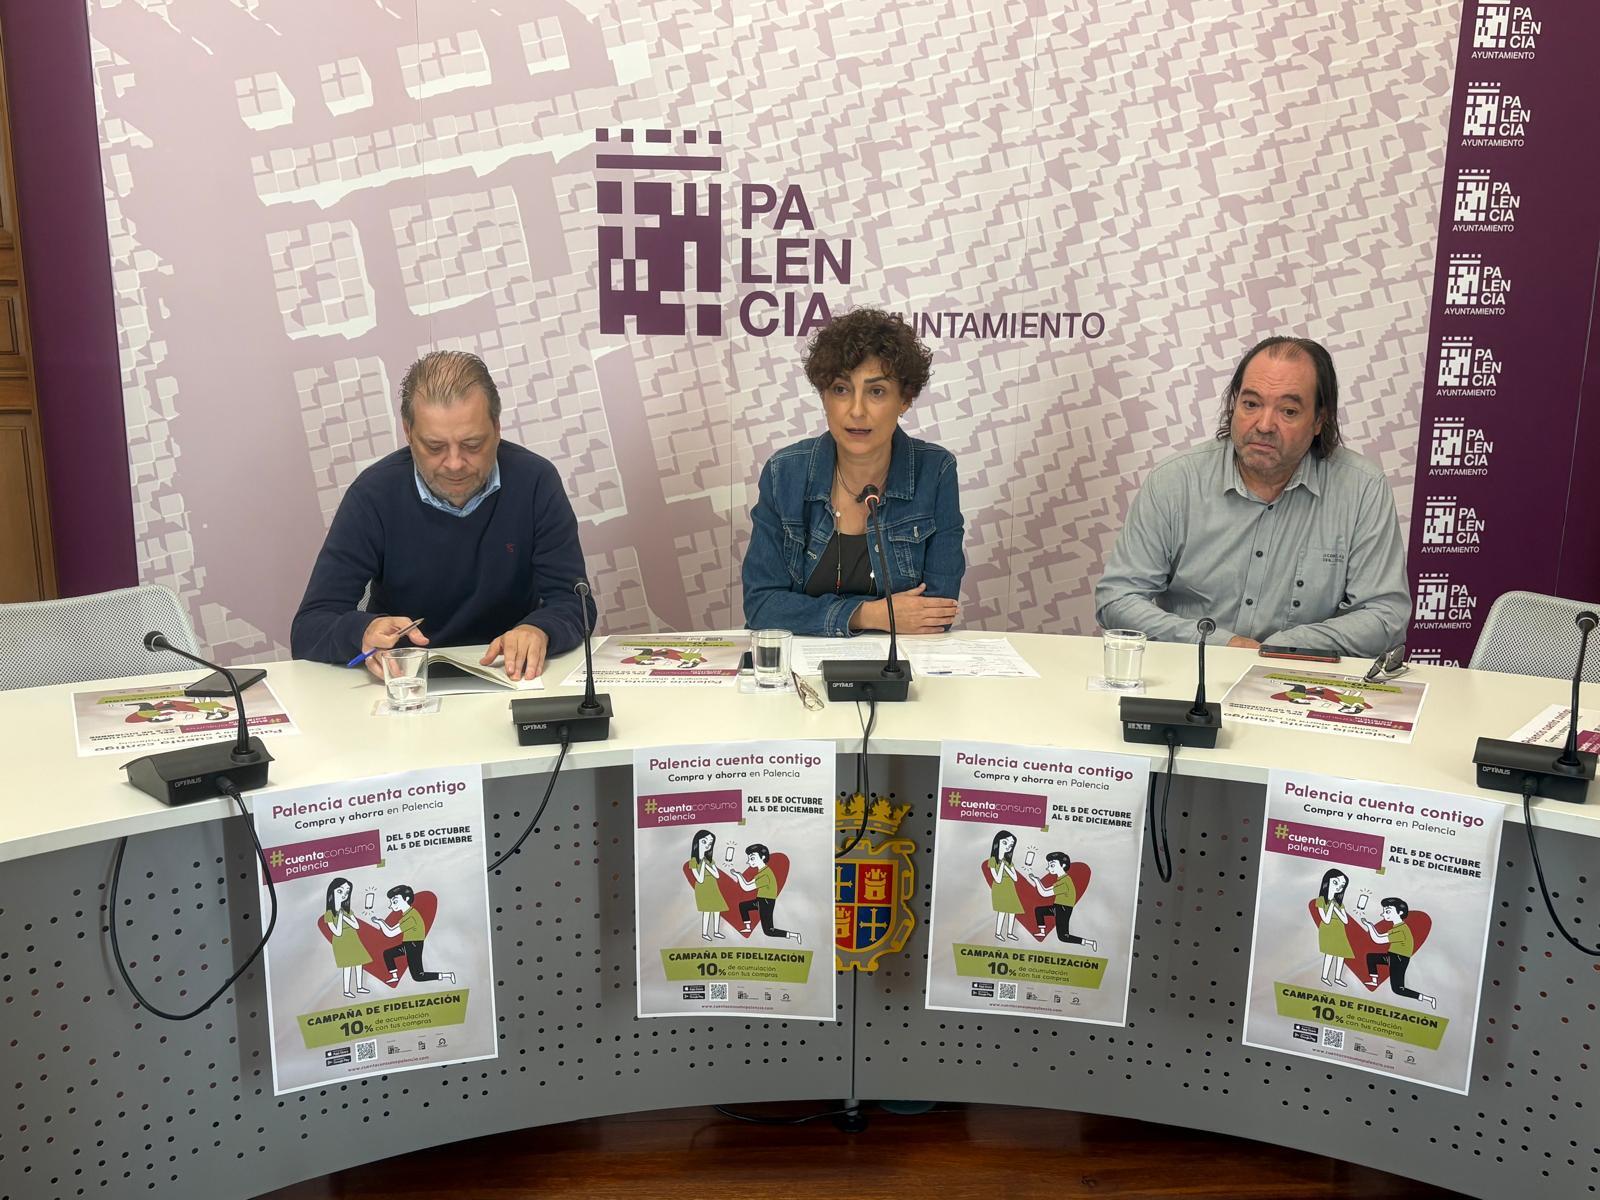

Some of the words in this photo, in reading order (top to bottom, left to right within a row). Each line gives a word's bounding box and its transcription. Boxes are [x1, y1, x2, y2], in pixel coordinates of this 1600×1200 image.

[1513, 7, 1533, 20] PA
[1511, 22, 1542, 35] LEN
[1509, 35, 1536, 49] CIA
[1471, 51, 1535, 60] AYUNTAMIENTO
[1502, 95, 1522, 109] PA
[1500, 109, 1531, 123] LEN
[1499, 123, 1525, 136] CIA
[1461, 139, 1525, 147] AYUNTAMIENTO
[1492, 182, 1511, 195] PA
[741, 183, 815, 230] PA
[1490, 195, 1520, 208] LEN
[1489, 209, 1515, 222] CIA
[1452, 224, 1514, 232] AYUNTAMIENTO
[741, 238, 852, 285] LEN
[1483, 266, 1502, 279] PA
[1482, 279, 1511, 292] LEN
[1480, 293, 1506, 305] CIA
[739, 290, 833, 338] CIA
[1444, 307, 1506, 315] AYUNTAMIENTO
[1475, 348, 1493, 361] PA
[1473, 361, 1502, 374] LEN
[1472, 374, 1497, 387] CIA
[1466, 429, 1485, 441] PA
[1465, 441, 1494, 454] LEN
[1463, 454, 1488, 466] CIA
[1428, 468, 1488, 476] AYUNTAMIENTO
[1458, 507, 1477, 519] PA
[1457, 520, 1485, 532] LEN
[1456, 532, 1480, 544] CIA
[1450, 584, 1468, 596] PA
[1449, 596, 1477, 608] LEN
[1448, 608, 1472, 620] CIA
[522, 723, 548, 731] OPTIMUS
[650, 756, 711, 771] Palencia
[715, 753, 764, 767] cuenta
[769, 753, 821, 768] contigo
[956, 752, 1018, 768] Palencia
[1023, 761, 1073, 773] cuenta
[1078, 766, 1133, 782] contigo
[668, 774, 704, 782] Compra
[715, 771, 747, 779] ahorra
[763, 769, 800, 778] Palencia
[1482, 766, 1511, 775] OPTIMUS
[174, 776, 202, 788] OPTIMUS
[973, 770, 1010, 781] Compra
[1021, 775, 1054, 785] ahorra
[1071, 779, 1109, 790] Palencia
[273, 797, 342, 819] Palencia
[348, 788, 402, 806] cuenta
[408, 780, 466, 796] contigo
[644, 798, 738, 814] #cuentaconsumo
[785, 796, 823, 805] OCTUBRE
[948, 791, 1042, 815] #cuentaconsumo
[1285, 782, 1353, 805] Palencia
[1359, 797, 1414, 814] cuenta
[1420, 808, 1484, 828] contigo
[294, 817, 336, 829] Compra
[339, 816, 345, 824] y
[348, 810, 384, 821] ahorra
[402, 800, 443, 812] Palencia
[780, 806, 824, 814] DICIEMBRE
[960, 808, 999, 819] palencia
[1052, 804, 1068, 812] DEL
[1091, 808, 1131, 819] OCTUBRE
[657, 812, 696, 823] palencia
[1086, 817, 1132, 828] DICIEMBRE
[1303, 804, 1344, 817] Compra
[1347, 812, 1353, 820] y
[1356, 812, 1392, 825] ahorra
[1412, 821, 1456, 836] Palencia
[386, 833, 404, 842] DEL
[413, 830, 425, 838] DE
[428, 826, 470, 836] OCTUBRE
[1273, 823, 1378, 855] #cuentaconsumo
[387, 844, 398, 852] AL
[409, 840, 421, 848] DE
[423, 835, 472, 846] DICIEMBRE
[1287, 842, 1330, 856] palencia
[270, 841, 375, 868] #cuentaconsumo
[1390, 845, 1408, 855] DEL
[1419, 851, 1432, 859] DE
[1434, 854, 1481, 869] OCTUBRE
[285, 859, 329, 877] palencia
[1389, 855, 1401, 863] AL
[1412, 859, 1425, 868] DE
[1428, 862, 1481, 878] DICIEMBRE
[669, 950, 717, 961] CAMPAÑA
[736, 952, 805, 963] FIDELIZACIÓN
[960, 948, 1009, 959] CAMPAÑA
[1012, 953, 1025, 961] DE
[1028, 955, 1099, 970] FIDELIZACIÓN
[697, 963, 726, 977] 10%
[987, 962, 1016, 977] 10%
[307, 1009, 363, 1026] CAMPAÑA
[366, 1006, 380, 1015] DE
[383, 994, 460, 1012] FIDELIZACIÓN
[1282, 989, 1336, 1005] CAMPAÑA
[1339, 1000, 1354, 1009] DE
[1357, 1003, 1438, 1029] FIDELIZACIÓN
[1311, 1006, 1344, 1024] 10%
[385, 1012, 430, 1023] acumulación
[1357, 1016, 1402, 1031] acumulación
[339, 1020, 374, 1037] 10%
[390, 1023, 400, 1031] tus
[402, 1019, 432, 1030] compras
[1373, 1026, 1404, 1037] compras
